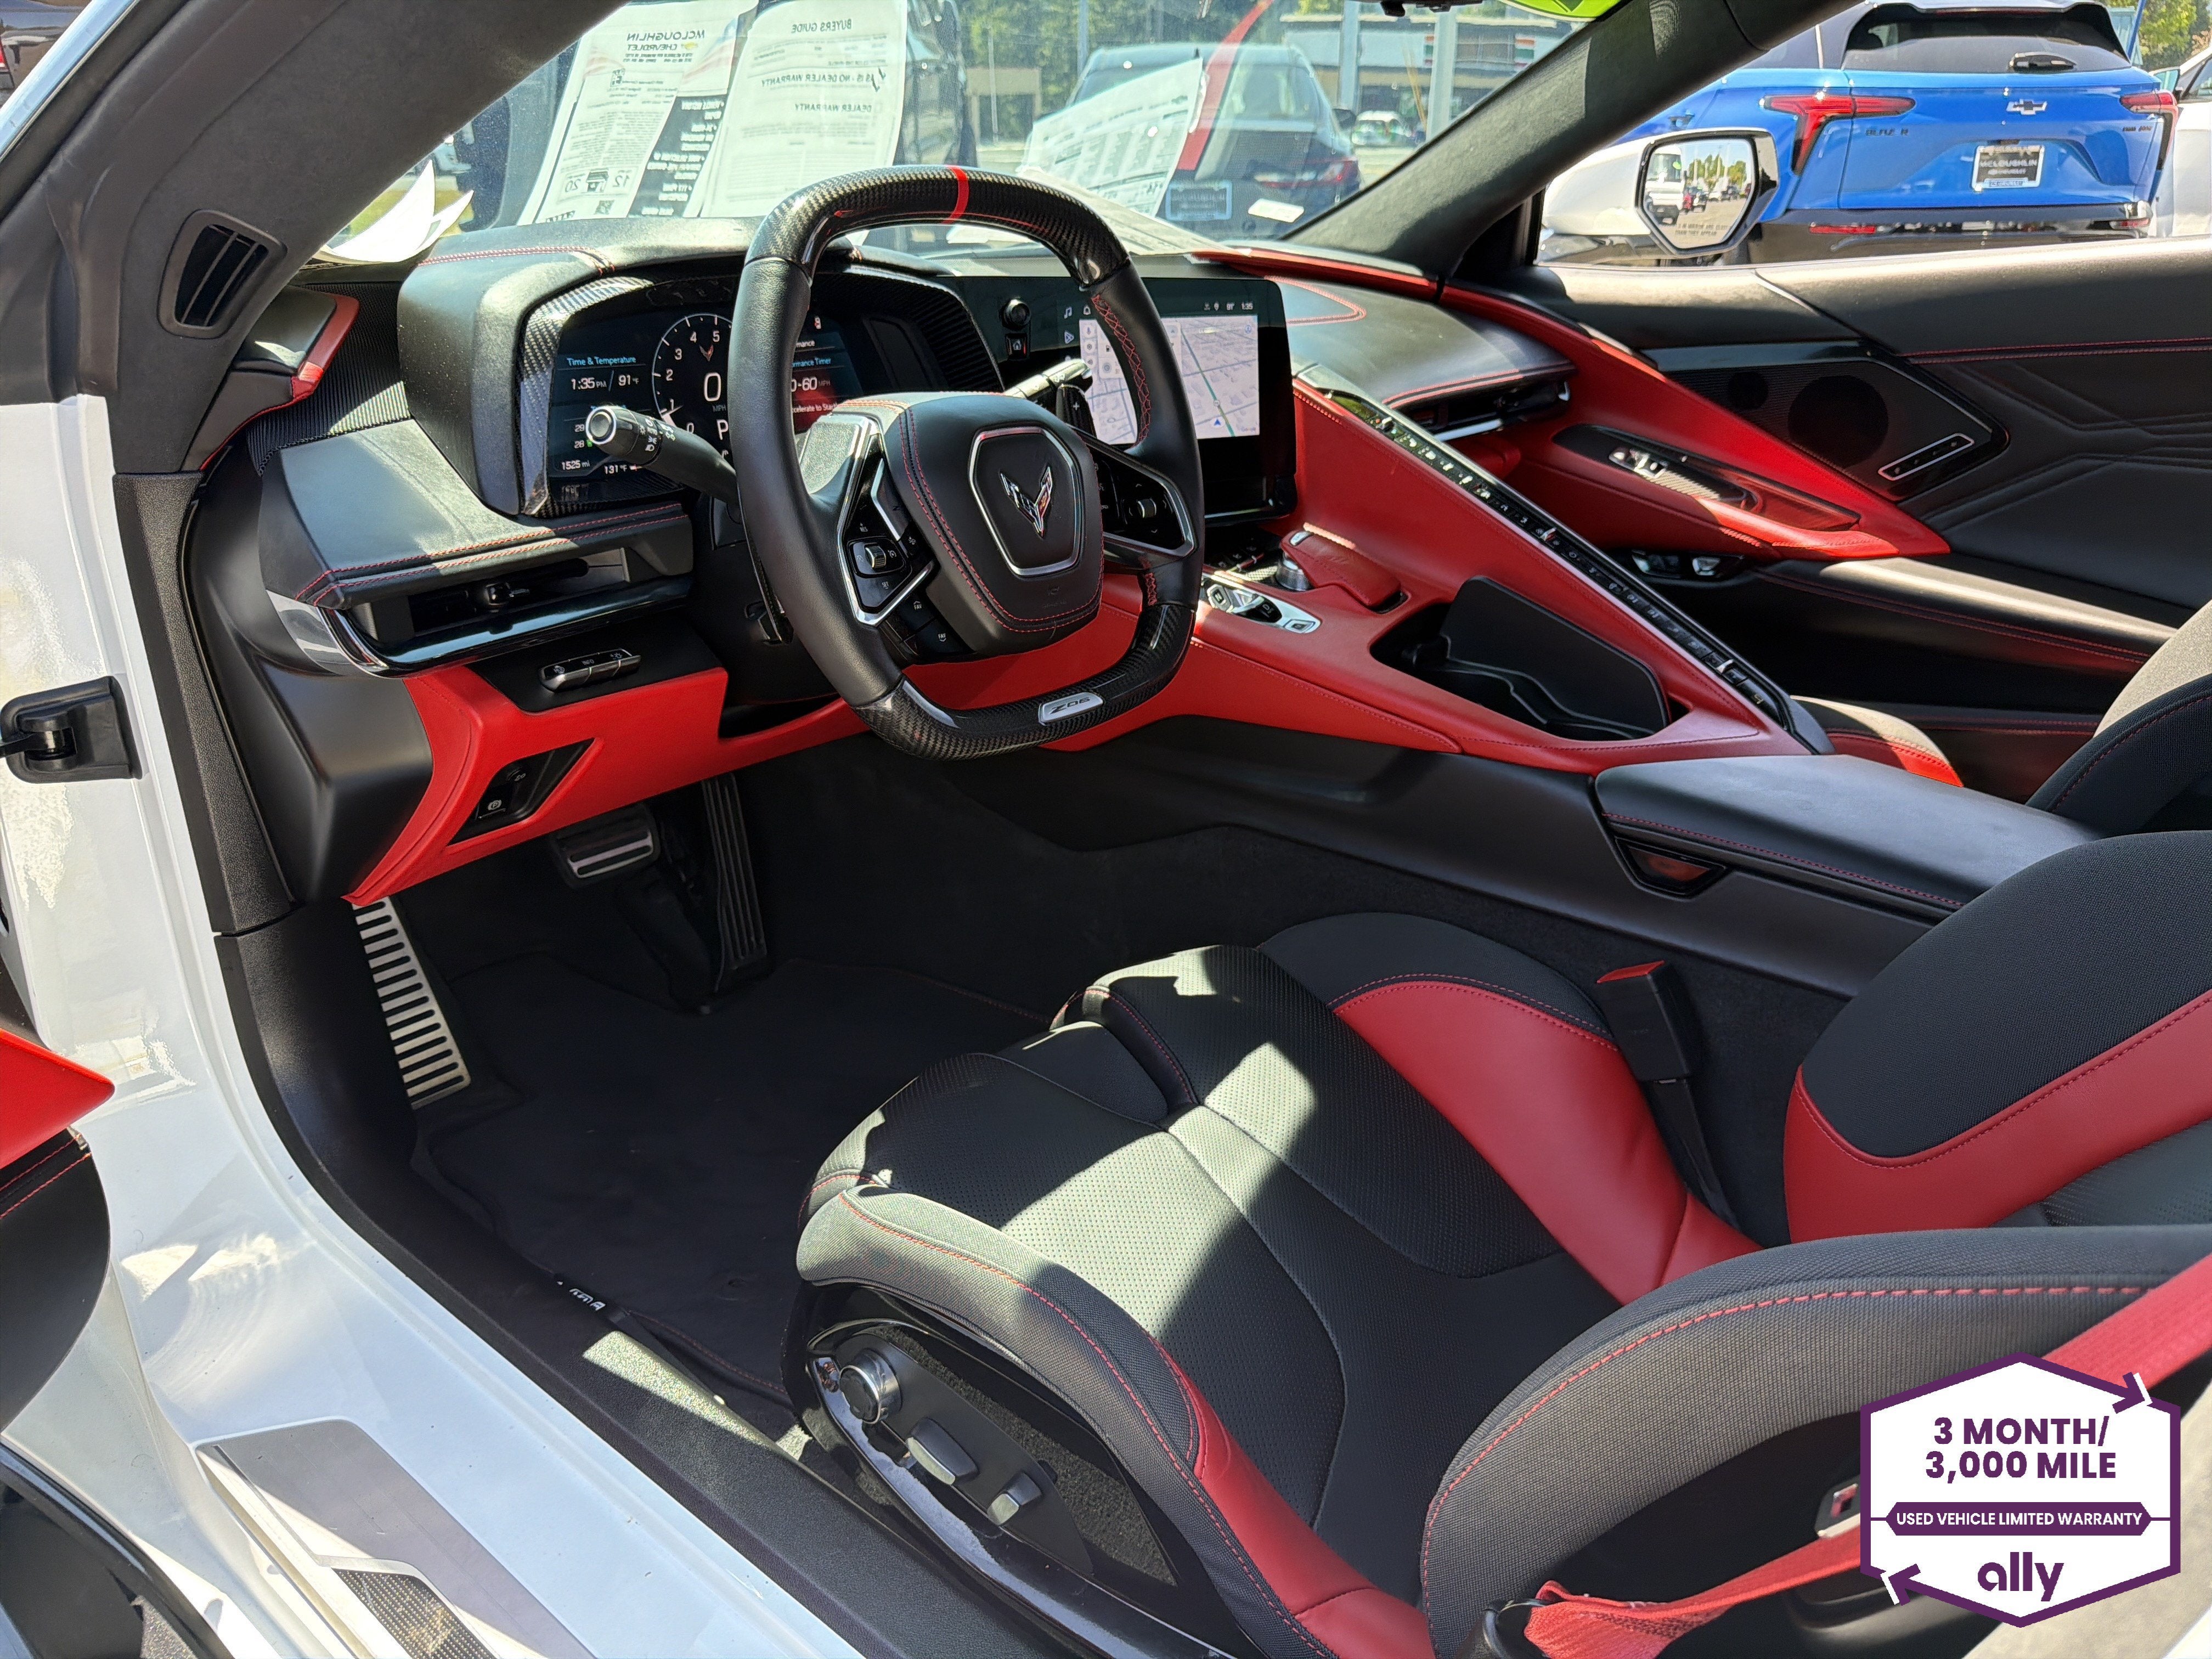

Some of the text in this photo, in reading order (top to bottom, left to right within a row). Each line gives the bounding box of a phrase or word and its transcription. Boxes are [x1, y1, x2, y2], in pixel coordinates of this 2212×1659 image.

[690, 331, 697, 343] 4
[713, 331, 720, 342] 5
[674, 348, 682, 360] 3
[567, 356, 636, 366] Time & Temperature
[815, 357, 831, 365] Timer
[618, 374, 631, 386] 91
[666, 369, 673, 381] 2
[571, 377, 595, 390] 1:35
[704, 372, 721, 402] 0
[670, 398, 675, 410] 1
[574, 424, 585, 433] 29
[686, 422, 695, 435] 0
[716, 419, 729, 440] P
[574, 439, 585, 449] 28
[561, 460, 590, 471] 1525 mi
[605, 465, 618, 475] 131
[1049, 697, 1091, 715] Z06
